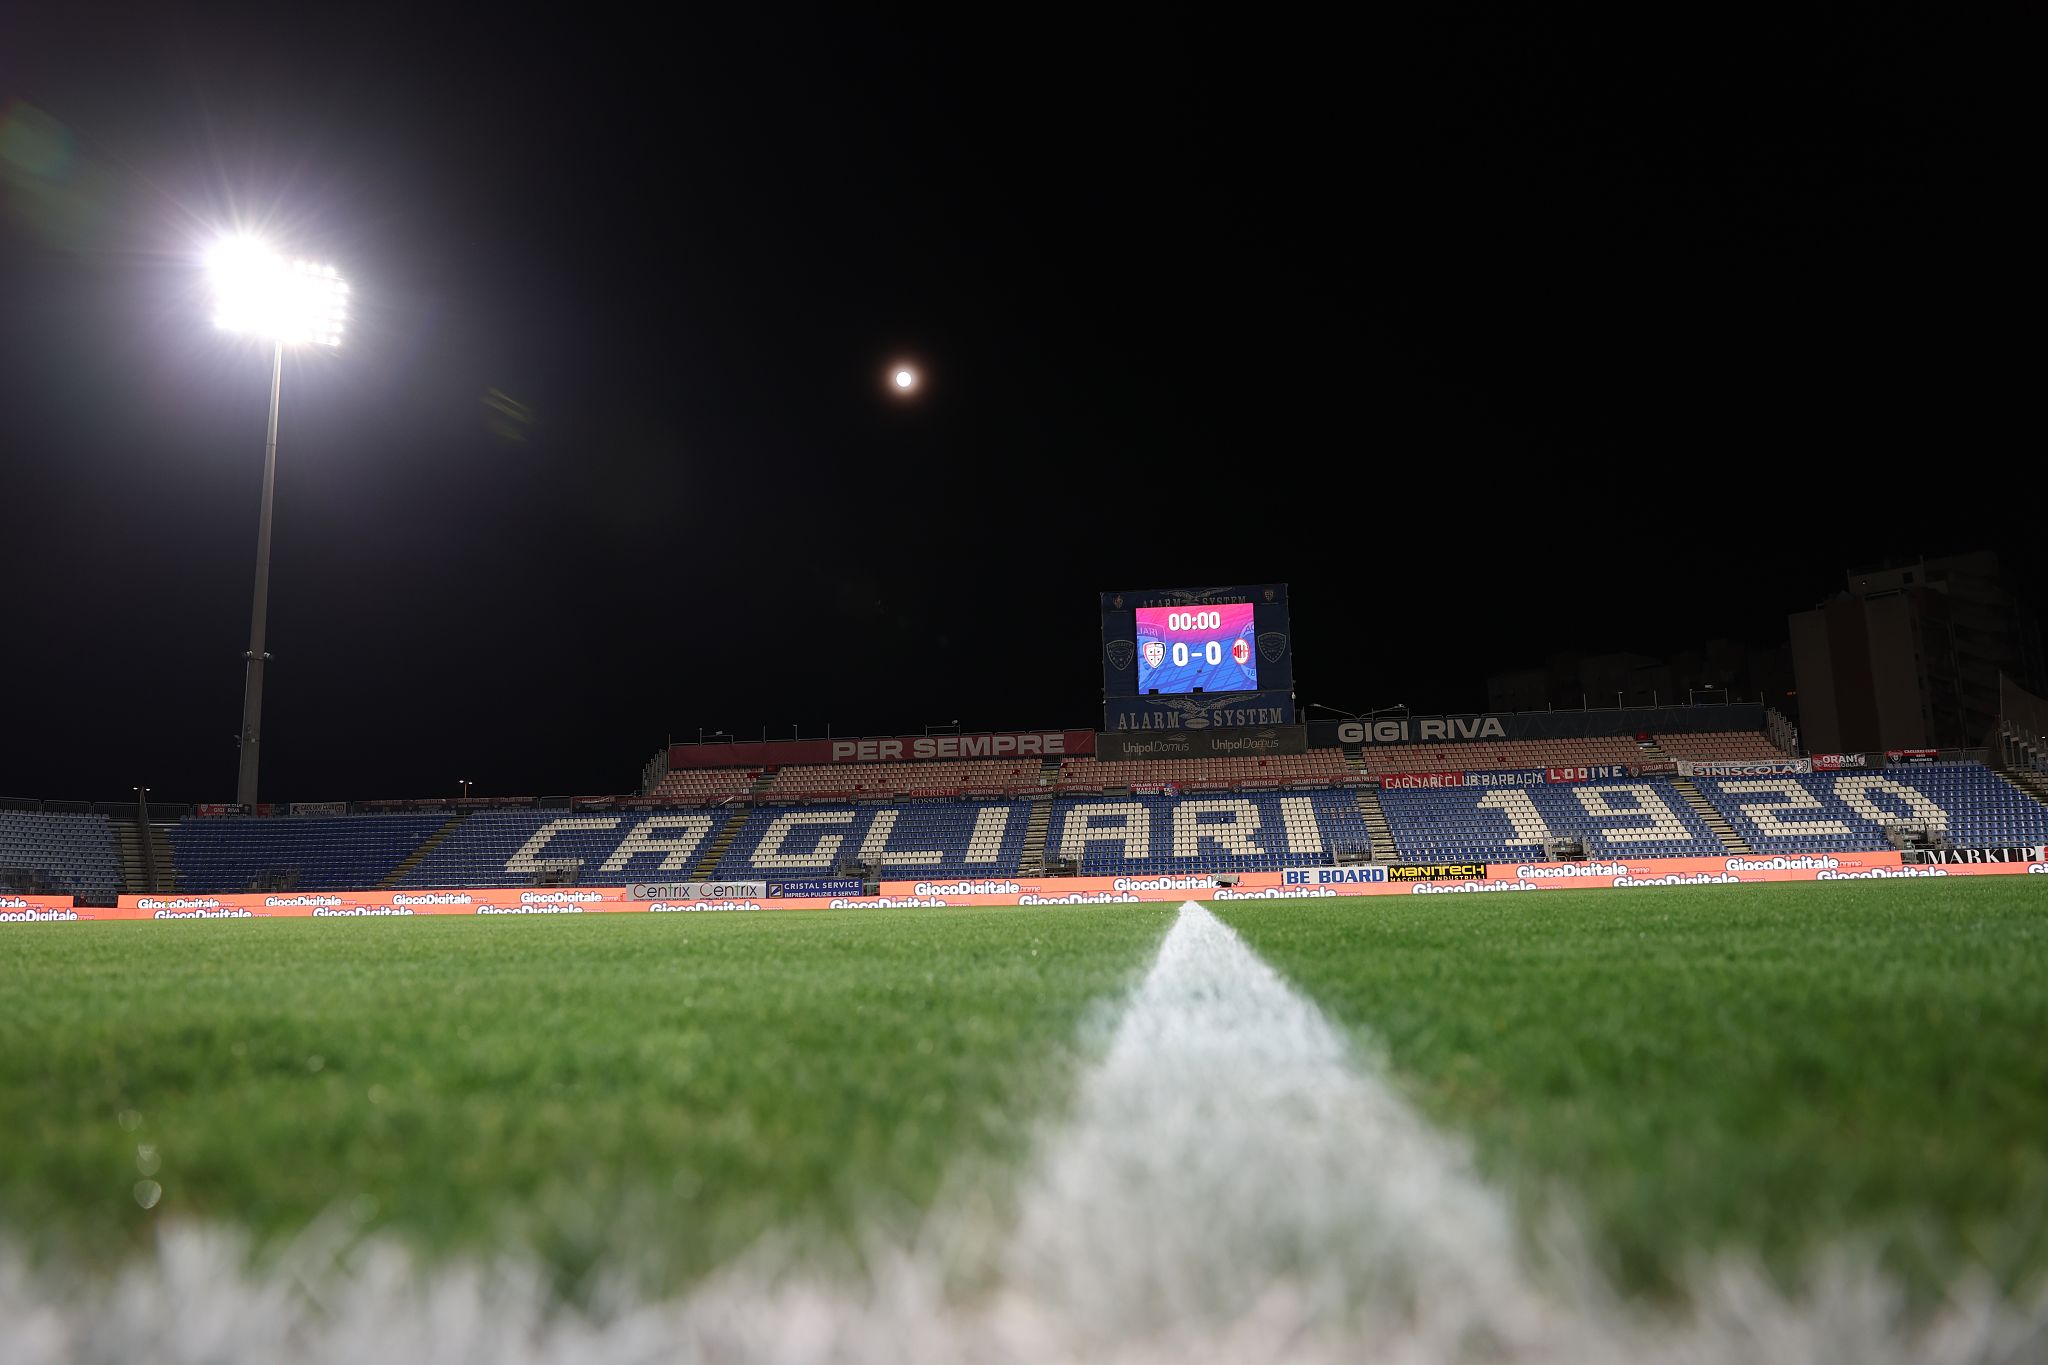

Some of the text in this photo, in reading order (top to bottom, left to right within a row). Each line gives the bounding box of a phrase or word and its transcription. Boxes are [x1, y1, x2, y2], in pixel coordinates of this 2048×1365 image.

[1168, 611, 1220, 631] 00:00
[1118, 708, 1283, 730] ALARM SYSTEM
[1337, 717, 1507, 743] GIGI RIVA
[832, 733, 1066, 762] PER SEMPRE
[1122, 741, 1190, 755] UnipolDomus
[1211, 737, 1279, 753] UnipolDomus
[1822, 754, 1859, 764] ORANI
[1551, 766, 1623, 781] LODINE
[1693, 765, 1795, 777] SINISCOLA
[1385, 777, 1443, 789] CAGLIARI
[1445, 774, 1479, 787] CLUB
[1481, 773, 1544, 786] BARBAGIA
[911, 788, 955, 797] GIURISTI
[1516, 862, 1628, 878] GiocoDigitale
[1725, 855, 1839, 871] GiocoDigitale
[1286, 869, 1384, 884] BE BOARD
[633, 883, 691, 899] Centrix
[699, 883, 757, 898] Centrix
[822, 881, 859, 889] SERVICE
[914, 880, 1020, 896] GiocoDigitale
[265, 895, 342, 906] GiocoDigitale
[392, 892, 472, 905] GiocoDigitale
[520, 891, 602, 903] GiocoDigitale
